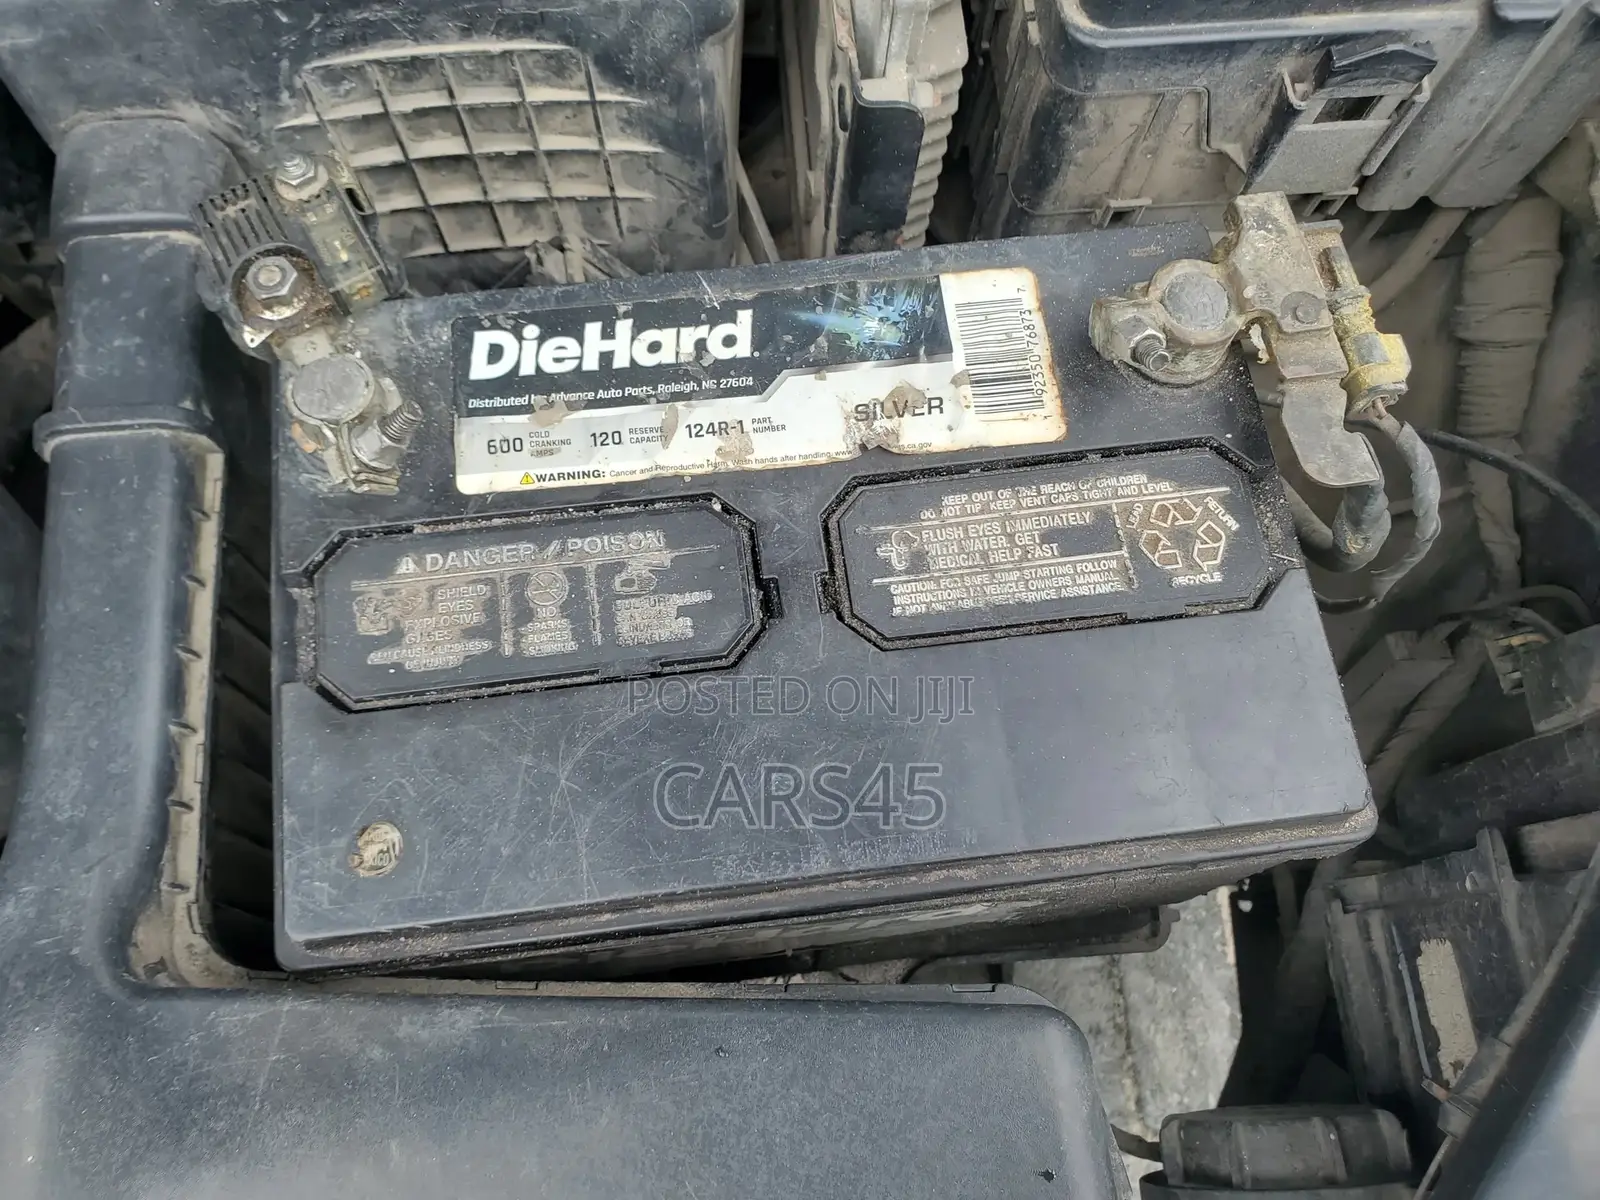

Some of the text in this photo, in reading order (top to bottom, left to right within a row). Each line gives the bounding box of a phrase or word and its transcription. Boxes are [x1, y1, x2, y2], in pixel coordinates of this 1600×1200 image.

[1020, 309, 1039, 348] 76873
[468, 309, 754, 381] DieHard
[1028, 354, 1048, 396] 92350
[468, 394, 529, 409] Distributed
[597, 389, 622, 400] Auto
[625, 385, 655, 397] Parts,
[658, 380, 699, 394] Raleigh,
[720, 376, 753, 388] 27604
[629, 425, 664, 435] RESERVE
[685, 419, 746, 439] 124R-1
[752, 416, 772, 425] PART
[753, 424, 786, 434] NUMBER
[529, 431, 550, 439] COLD
[530, 438, 572, 448] CRANKING
[590, 430, 622, 447] 120
[629, 434, 669, 445] CAPACITY
[487, 437, 523, 455] 600
[535, 469, 606, 483] WARNING:
[609, 469, 637, 478] Cancer
[639, 465, 654, 475] and
[655, 461, 705, 473] Reproductive
[731, 457, 754, 466] Wash
[754, 455, 778, 464] hands
[780, 453, 797, 463] after
[798, 450, 833, 462] handling.
[941, 494, 968, 506] KEEP
[972, 490, 993, 502] OUT
[1040, 483, 1076, 495] REACH
[1097, 474, 1148, 488] CHILDREN
[989, 499, 1016, 511] KEEP
[1021, 496, 1046, 508] VENT
[1051, 492, 1079, 504] CAPS
[1082, 488, 1112, 500] TIGHT
[1117, 485, 1138, 496] AND
[1141, 482, 1173, 494] LEVEL
[1126, 503, 1144, 529] LEAD
[1204, 496, 1240, 532] RETURN
[921, 511, 1091, 542] FLUSH EYES IMMEDIATELY
[923, 542, 958, 556] WITH
[1015, 531, 1040, 546] GET
[988, 547, 1021, 563] HELP
[1026, 543, 1058, 559] FAST
[964, 574, 989, 586] SAFE
[1023, 564, 1074, 580] STARTING
[1075, 560, 1117, 573] FOLLOW
[1171, 571, 1223, 589] RECYCLE
[437, 584, 487, 600] SHIELD
[893, 587, 967, 605] INSTRUCTIONS
[983, 581, 1025, 595] VEHICLE
[1028, 576, 1073, 591] OWNERS
[1075, 571, 1119, 585] MANUAL
[439, 599, 474, 614] EYES
[536, 606, 556, 618] NO
[405, 612, 482, 631] EXPLOSIVE
[527, 619, 568, 632] SPARKS
